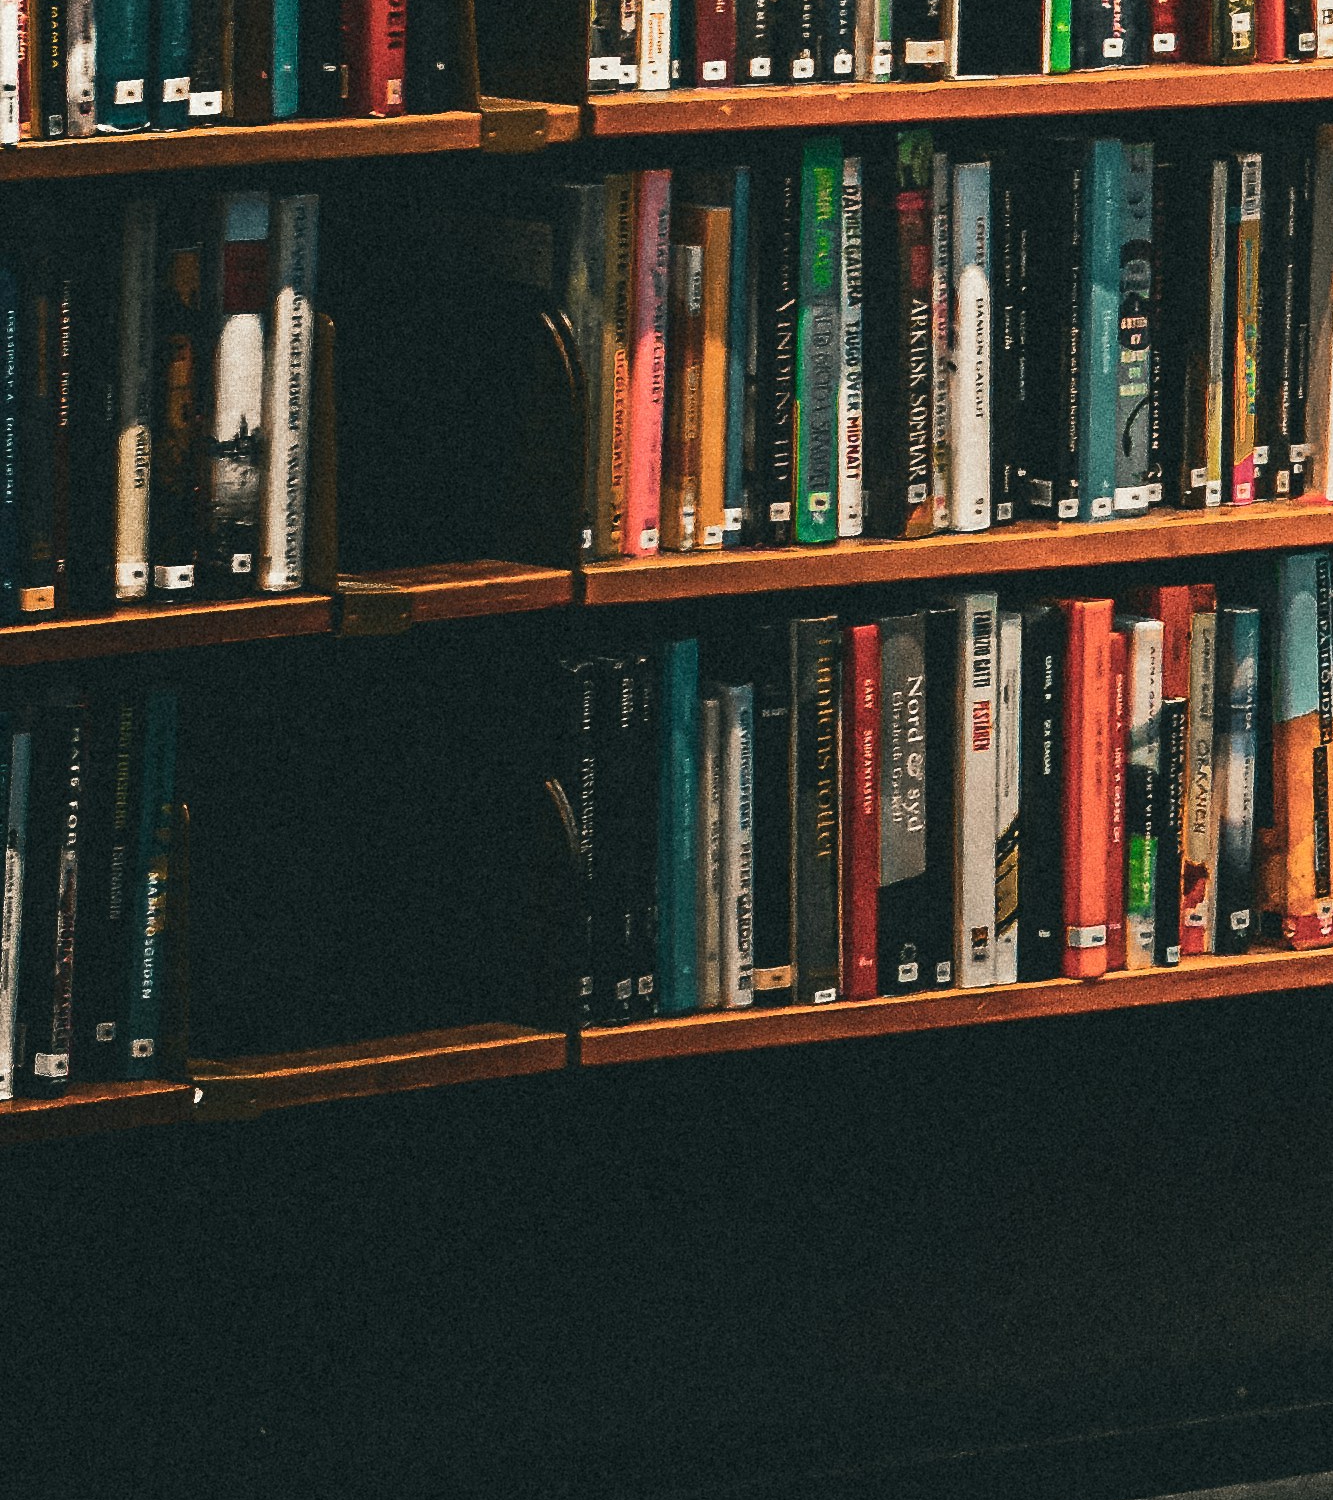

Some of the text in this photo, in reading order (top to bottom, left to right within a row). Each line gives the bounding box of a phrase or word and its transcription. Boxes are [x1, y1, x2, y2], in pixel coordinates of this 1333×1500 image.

[909, 299, 926, 481] ARKTISK SOMMAR
[847, 416, 859, 479] MIDNATT
[906, 675, 924, 742] Nord
[906, 788, 923, 831] syd
